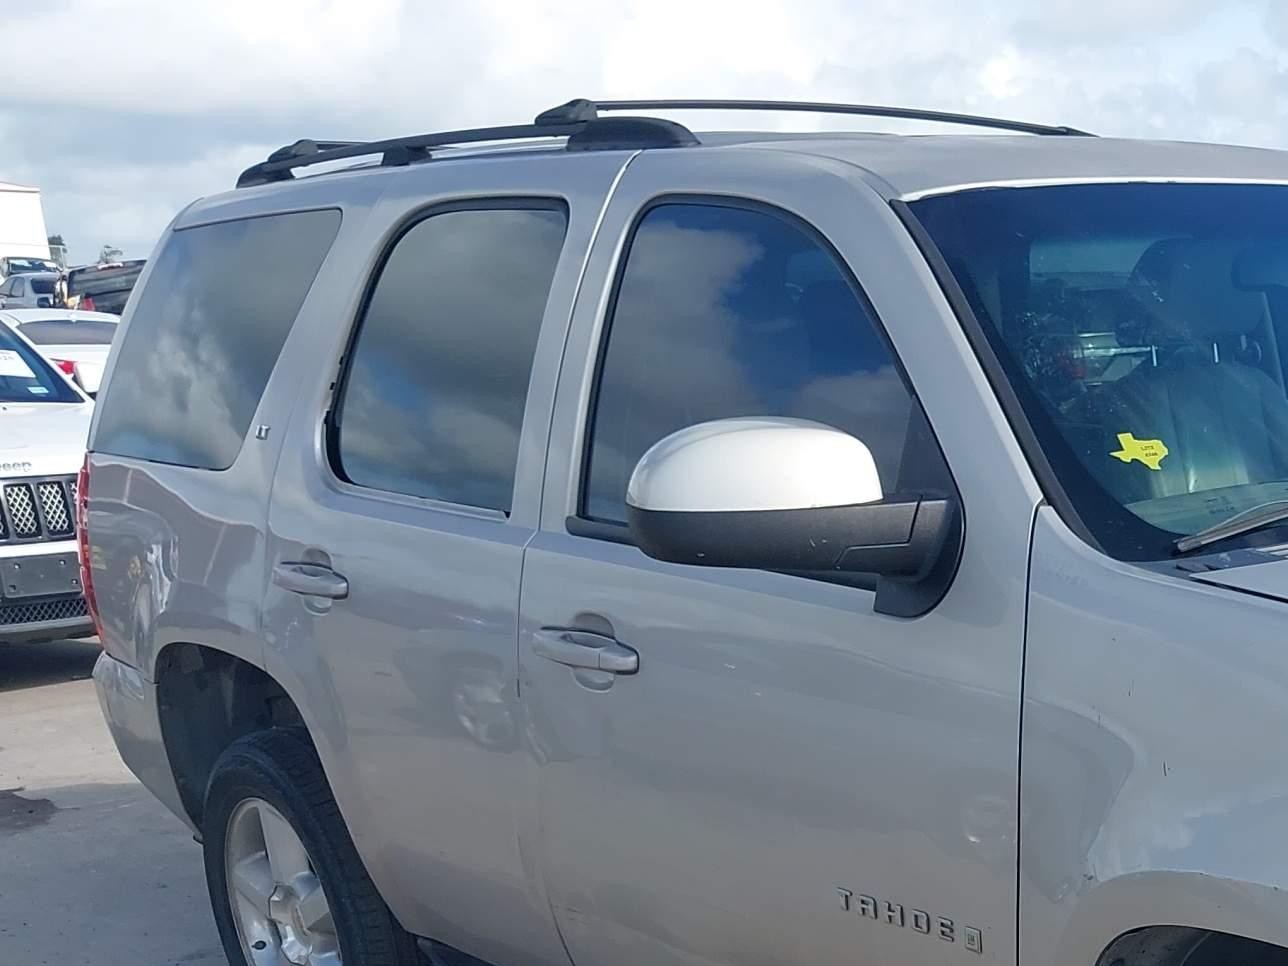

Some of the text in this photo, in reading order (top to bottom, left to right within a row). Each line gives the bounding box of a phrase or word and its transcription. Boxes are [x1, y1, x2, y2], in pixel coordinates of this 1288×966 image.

[255, 424, 271, 440] LT
[0, 461, 32, 472] eep
[835, 886, 956, 943] TAHOE
